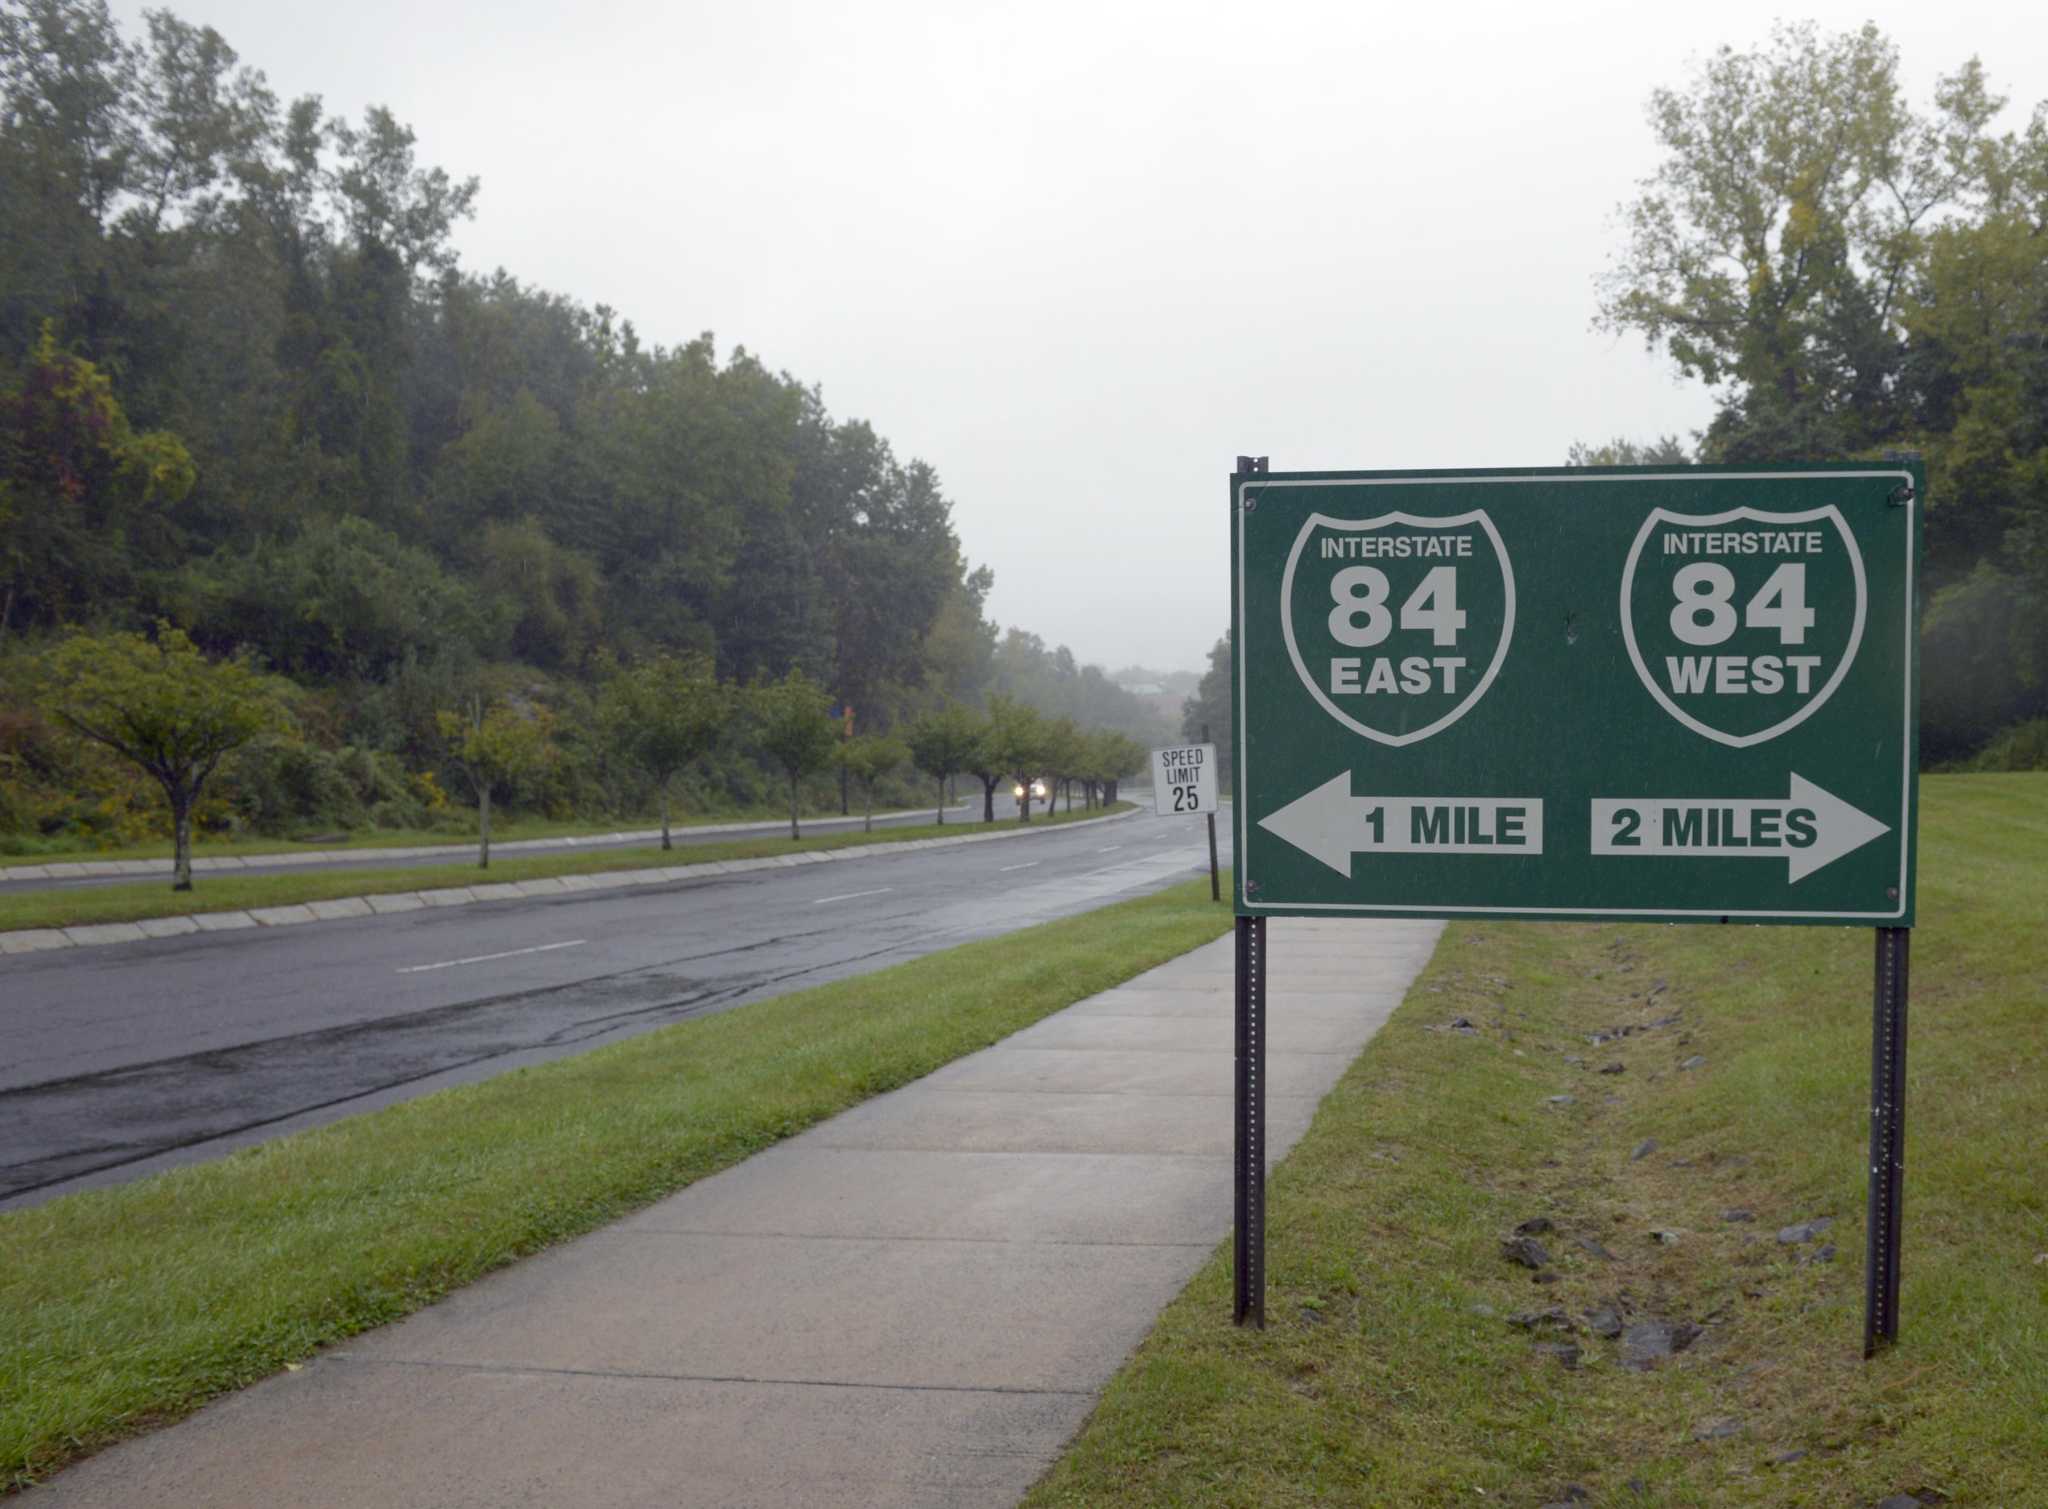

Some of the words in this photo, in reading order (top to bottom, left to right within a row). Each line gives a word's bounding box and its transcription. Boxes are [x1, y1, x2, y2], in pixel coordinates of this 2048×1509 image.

[1321, 535, 1473, 559] INTERSTATE
[1663, 531, 1823, 556] INTERSTATE
[1328, 565, 1467, 648] 84
[1669, 562, 1816, 645] 84
[1329, 656, 1467, 695] EAST
[1665, 655, 1822, 695] WEST
[1162, 748, 1204, 768] SPEED
[1166, 766, 1201, 785] LIMIT
[1172, 785, 1199, 812] 25
[1364, 806, 1384, 845] 1
[1411, 806, 1527, 846] MILE
[1610, 807, 1642, 847] 2
[1661, 807, 1818, 849] MILES
